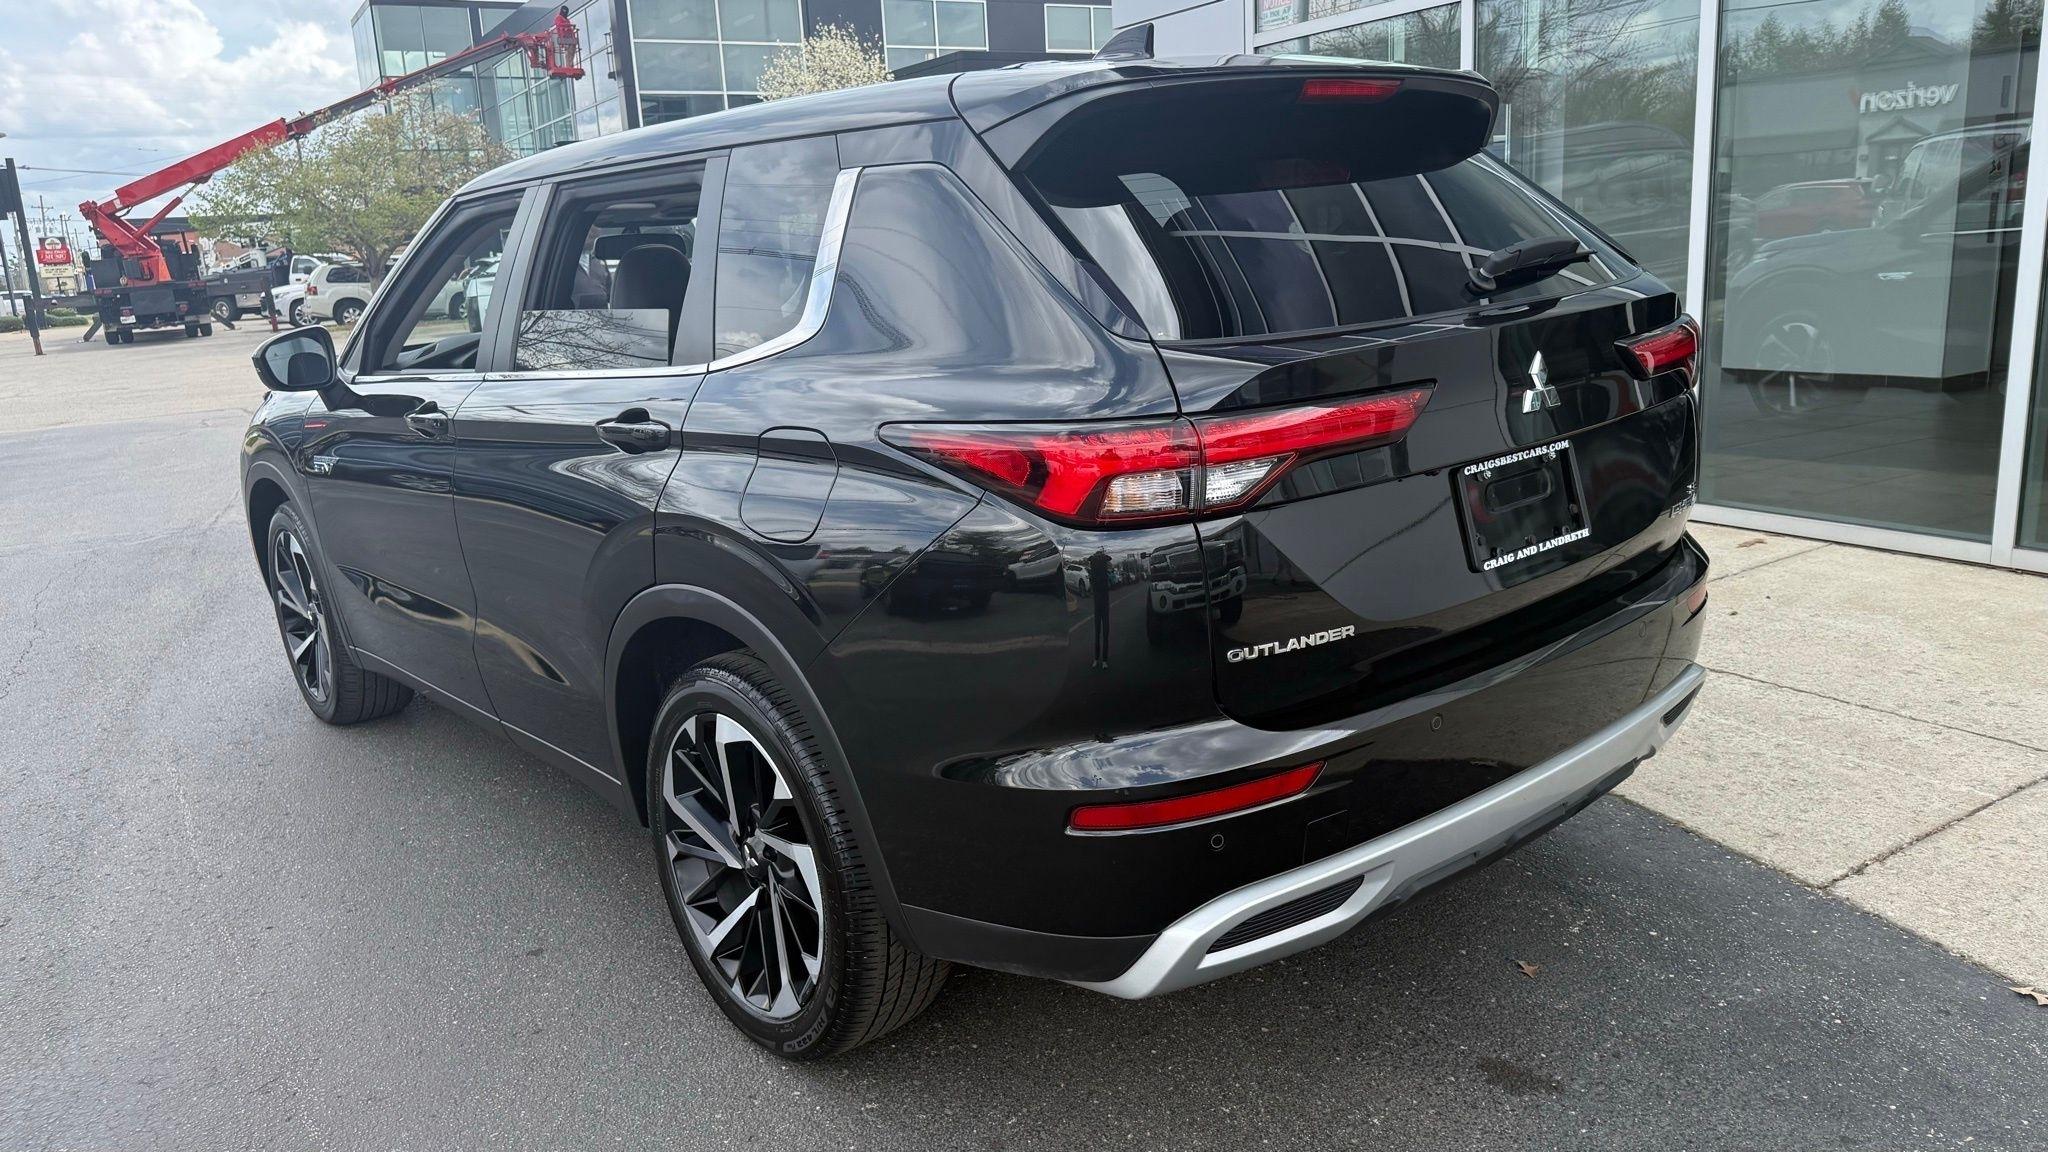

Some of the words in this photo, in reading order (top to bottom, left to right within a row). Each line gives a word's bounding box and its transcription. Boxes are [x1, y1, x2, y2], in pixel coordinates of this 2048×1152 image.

[1464, 439, 1570, 476] CRAIGSBESTCARS.COM
[1483, 555, 1515, 571] CRAIG
[1516, 545, 1538, 560] AND
[1539, 528, 1590, 552] LANDRETH
[1226, 624, 1355, 663] OUTLANDER
